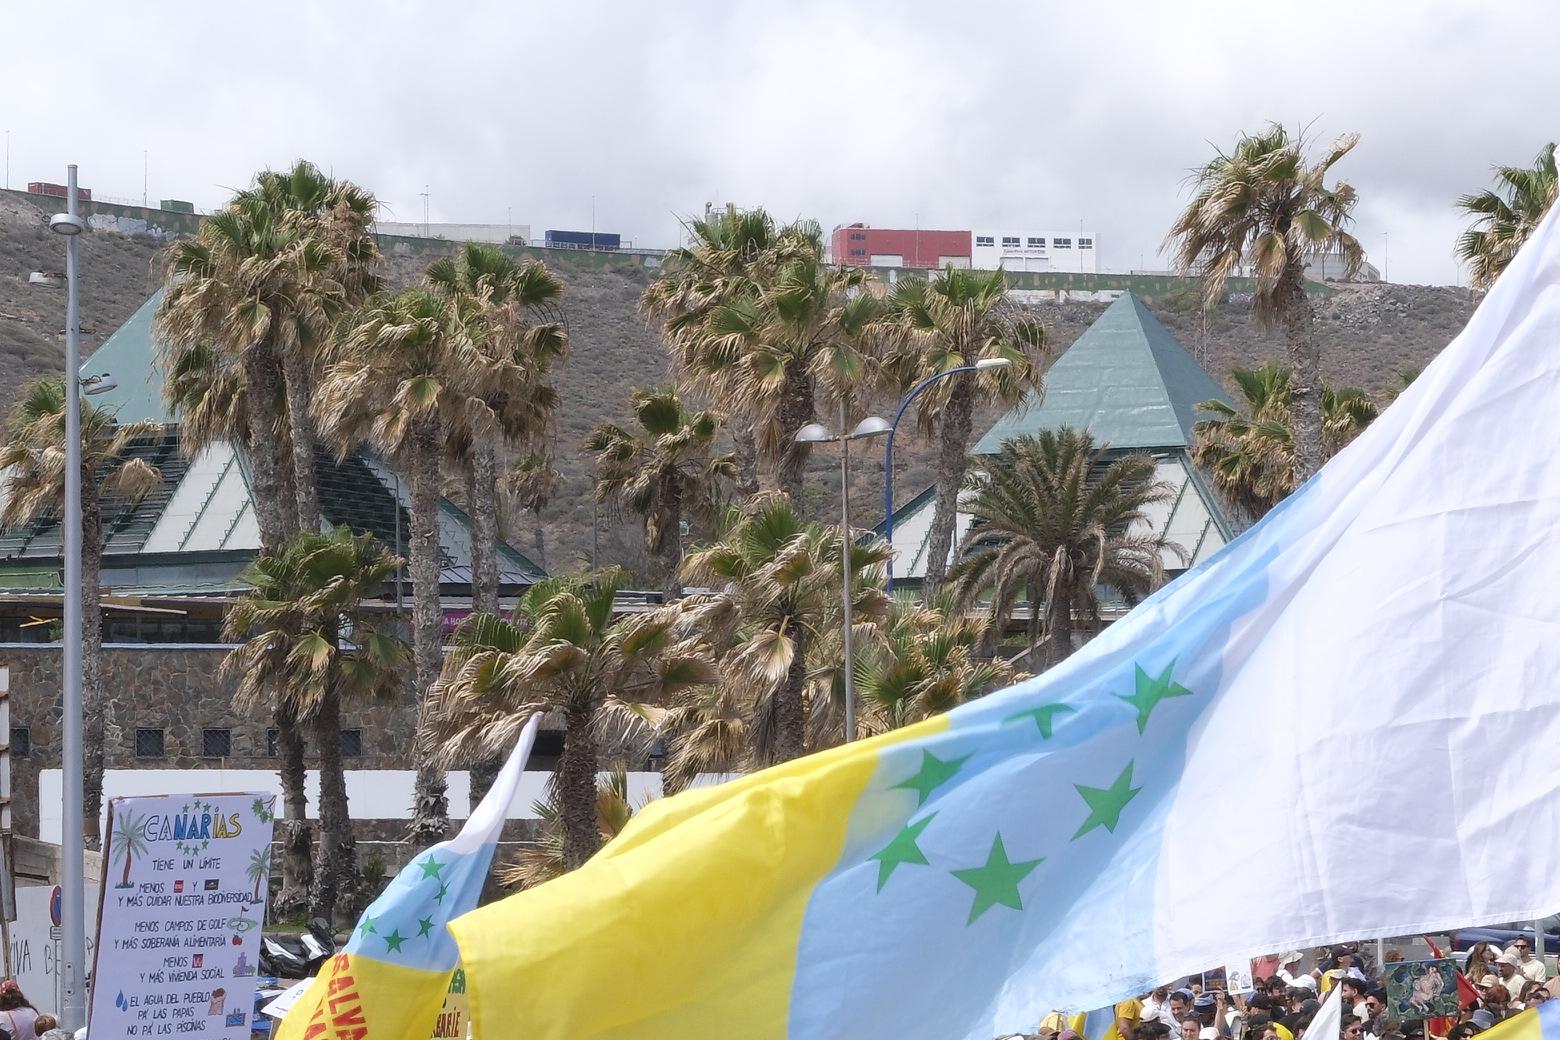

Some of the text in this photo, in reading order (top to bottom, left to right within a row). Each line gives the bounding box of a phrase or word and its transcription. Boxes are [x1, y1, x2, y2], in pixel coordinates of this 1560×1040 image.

[152, 858, 174, 871] TIENE
[183, 859, 193, 870] UN
[139, 882, 165, 893] MENOS
[192, 881, 198, 892] Y
[118, 896, 123, 907] Y
[146, 893, 171, 907] CUIDAR
[174, 894, 204, 906] NUESTRA
[208, 890, 253, 905] BIODIVERSIDAD
[134, 918, 227, 932] MENOS CAMPOS DE GOLF
[114, 939, 120, 949] Y
[163, 956, 188, 967] MENOS
[140, 972, 145, 983] Y
[168, 967, 198, 982] VIVIENDA
[200, 967, 225, 980] SOCIAL
[129, 991, 210, 1008] EL AGUA DEL PUEBLO
[153, 1008, 167, 1020] LAS
[172, 1007, 195, 1018] PAPAS
[127, 1024, 137, 1036] NO
[158, 1022, 171, 1034] LAS
[176, 1018, 206, 1032] PISCINAS
